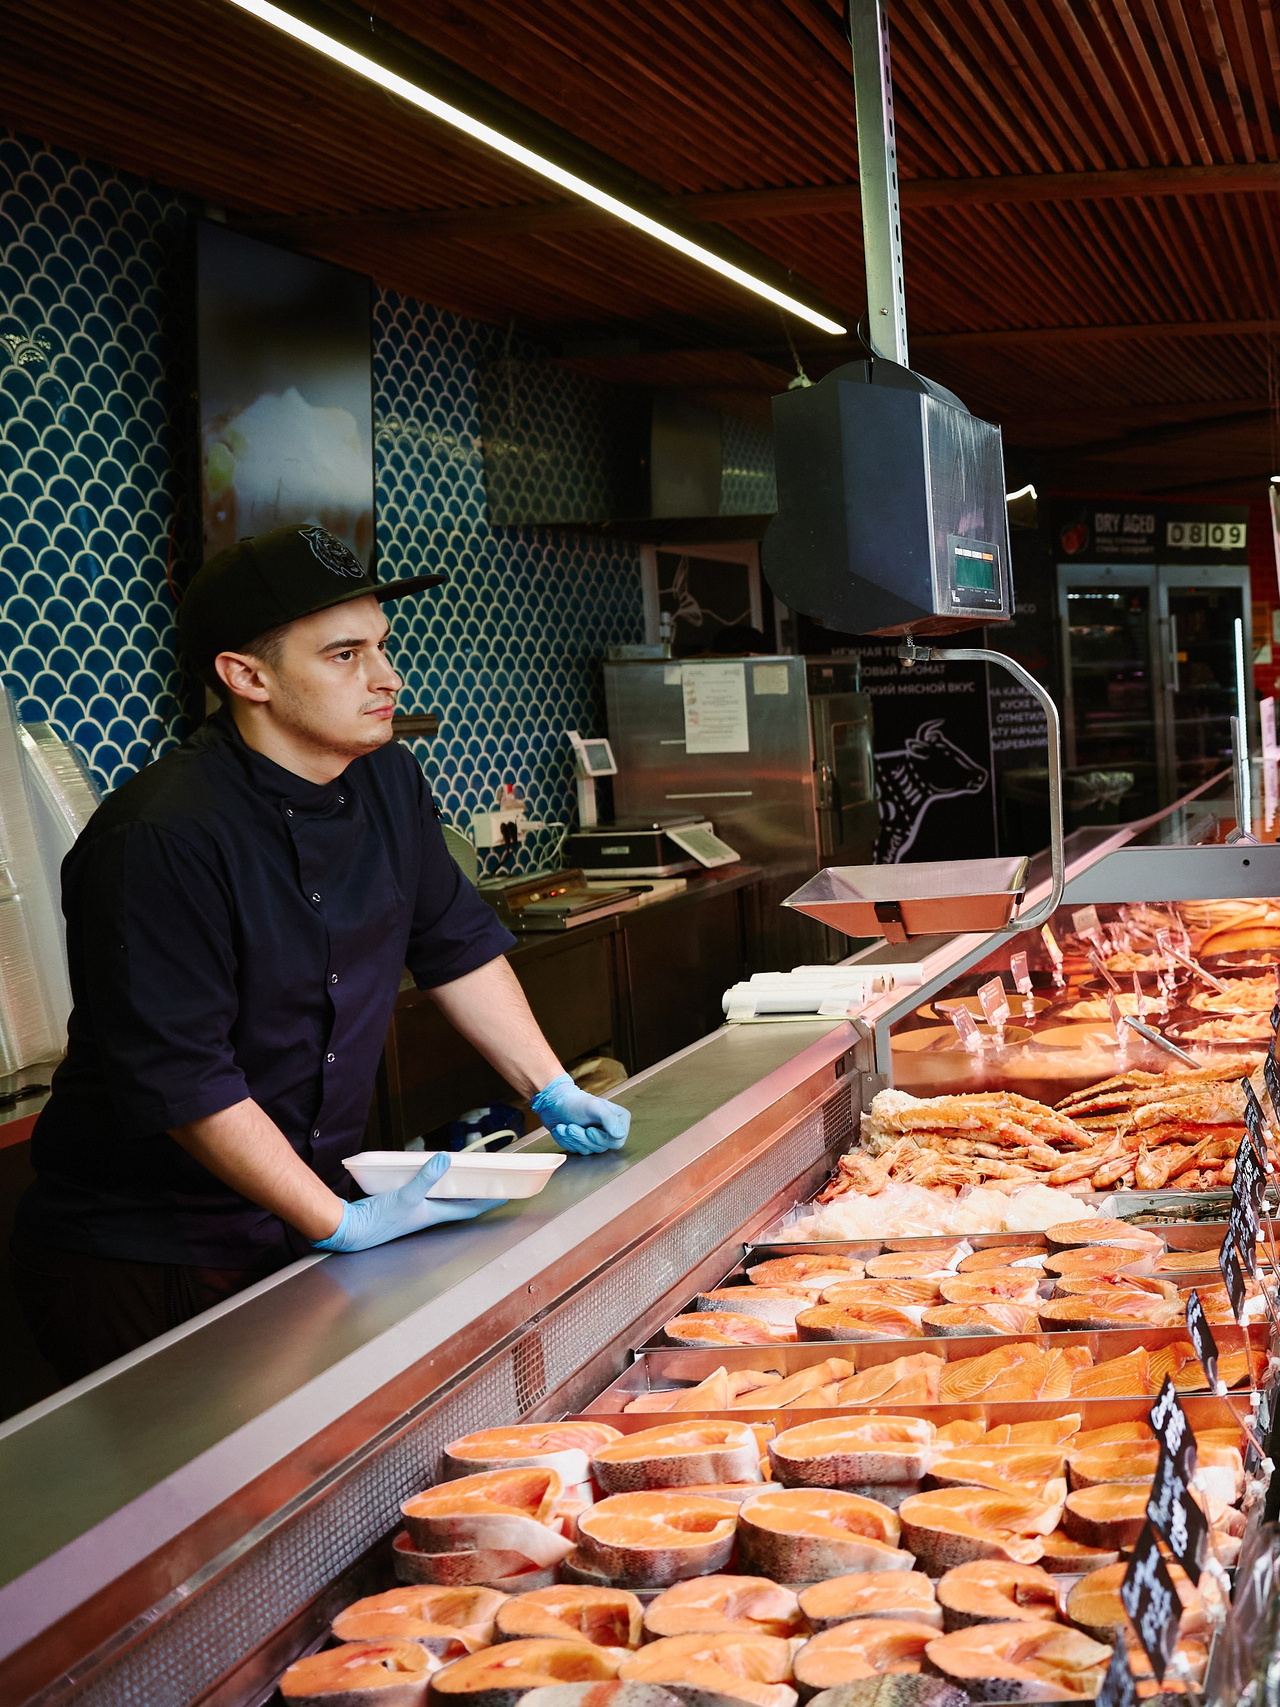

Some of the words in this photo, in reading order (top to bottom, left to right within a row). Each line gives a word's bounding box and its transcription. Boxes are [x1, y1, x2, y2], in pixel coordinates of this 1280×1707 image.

[1095, 513, 1120, 532] DRY
[1123, 513, 1155, 533] AGED
[1171, 524, 1203, 544] 08
[1212, 525, 1241, 546] 09
[861, 682, 896, 695] ОКИЙ
